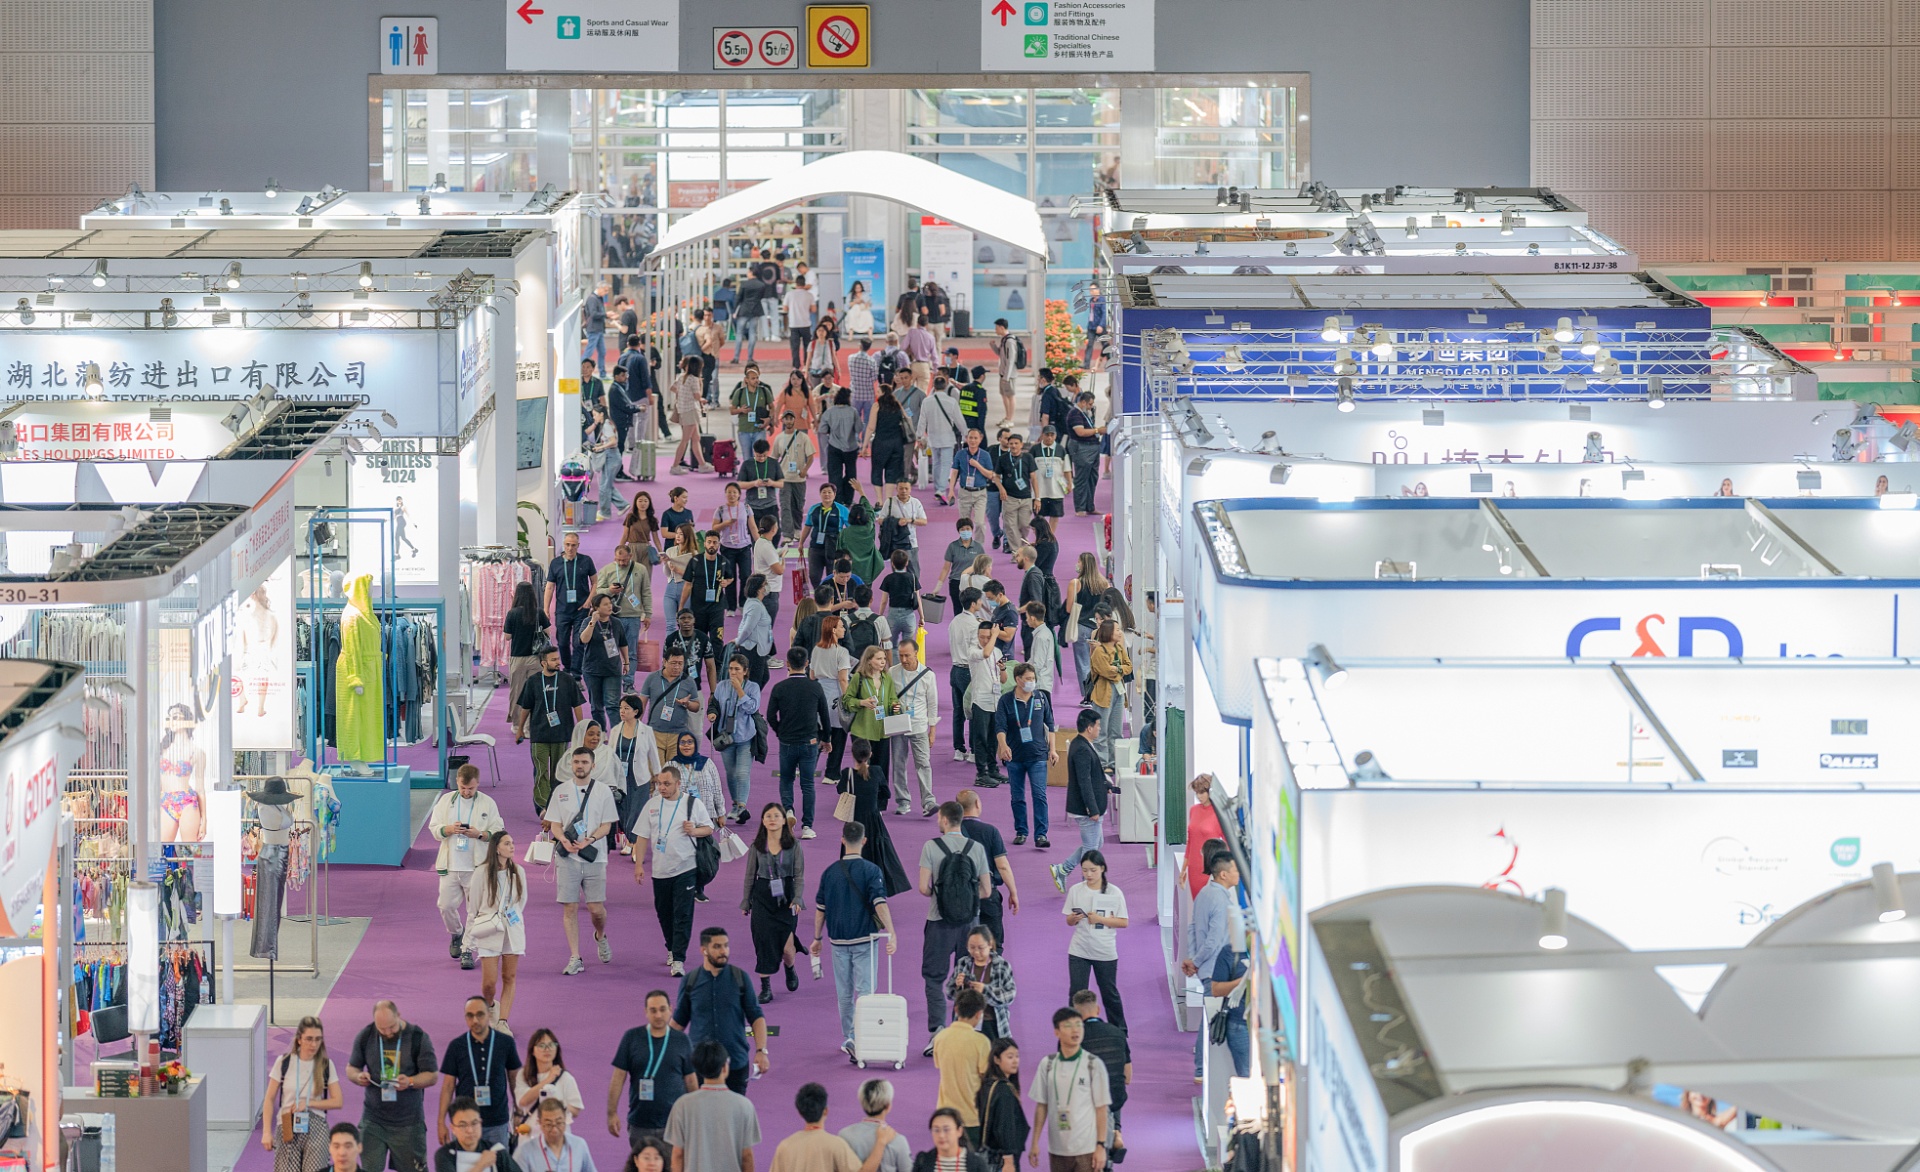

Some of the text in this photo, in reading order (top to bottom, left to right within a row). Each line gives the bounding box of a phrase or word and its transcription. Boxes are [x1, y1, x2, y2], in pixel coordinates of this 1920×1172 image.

[1068, 10, 1095, 18] Fittings
[586, 19, 610, 27] Sports
[586, 29, 639, 37] 运动服及休闲服
[724, 41, 748, 56] 5.5m
[1053, 42, 1092, 50] Specialties
[1463, 368, 1510, 376] GROP
[382, 439, 415, 454] ARTS
[43, 448, 115, 461] HOLDINGS
[119, 448, 175, 460] LIMITED
[365, 455, 433, 469] SEAMLESS
[382, 469, 417, 484] 2024
